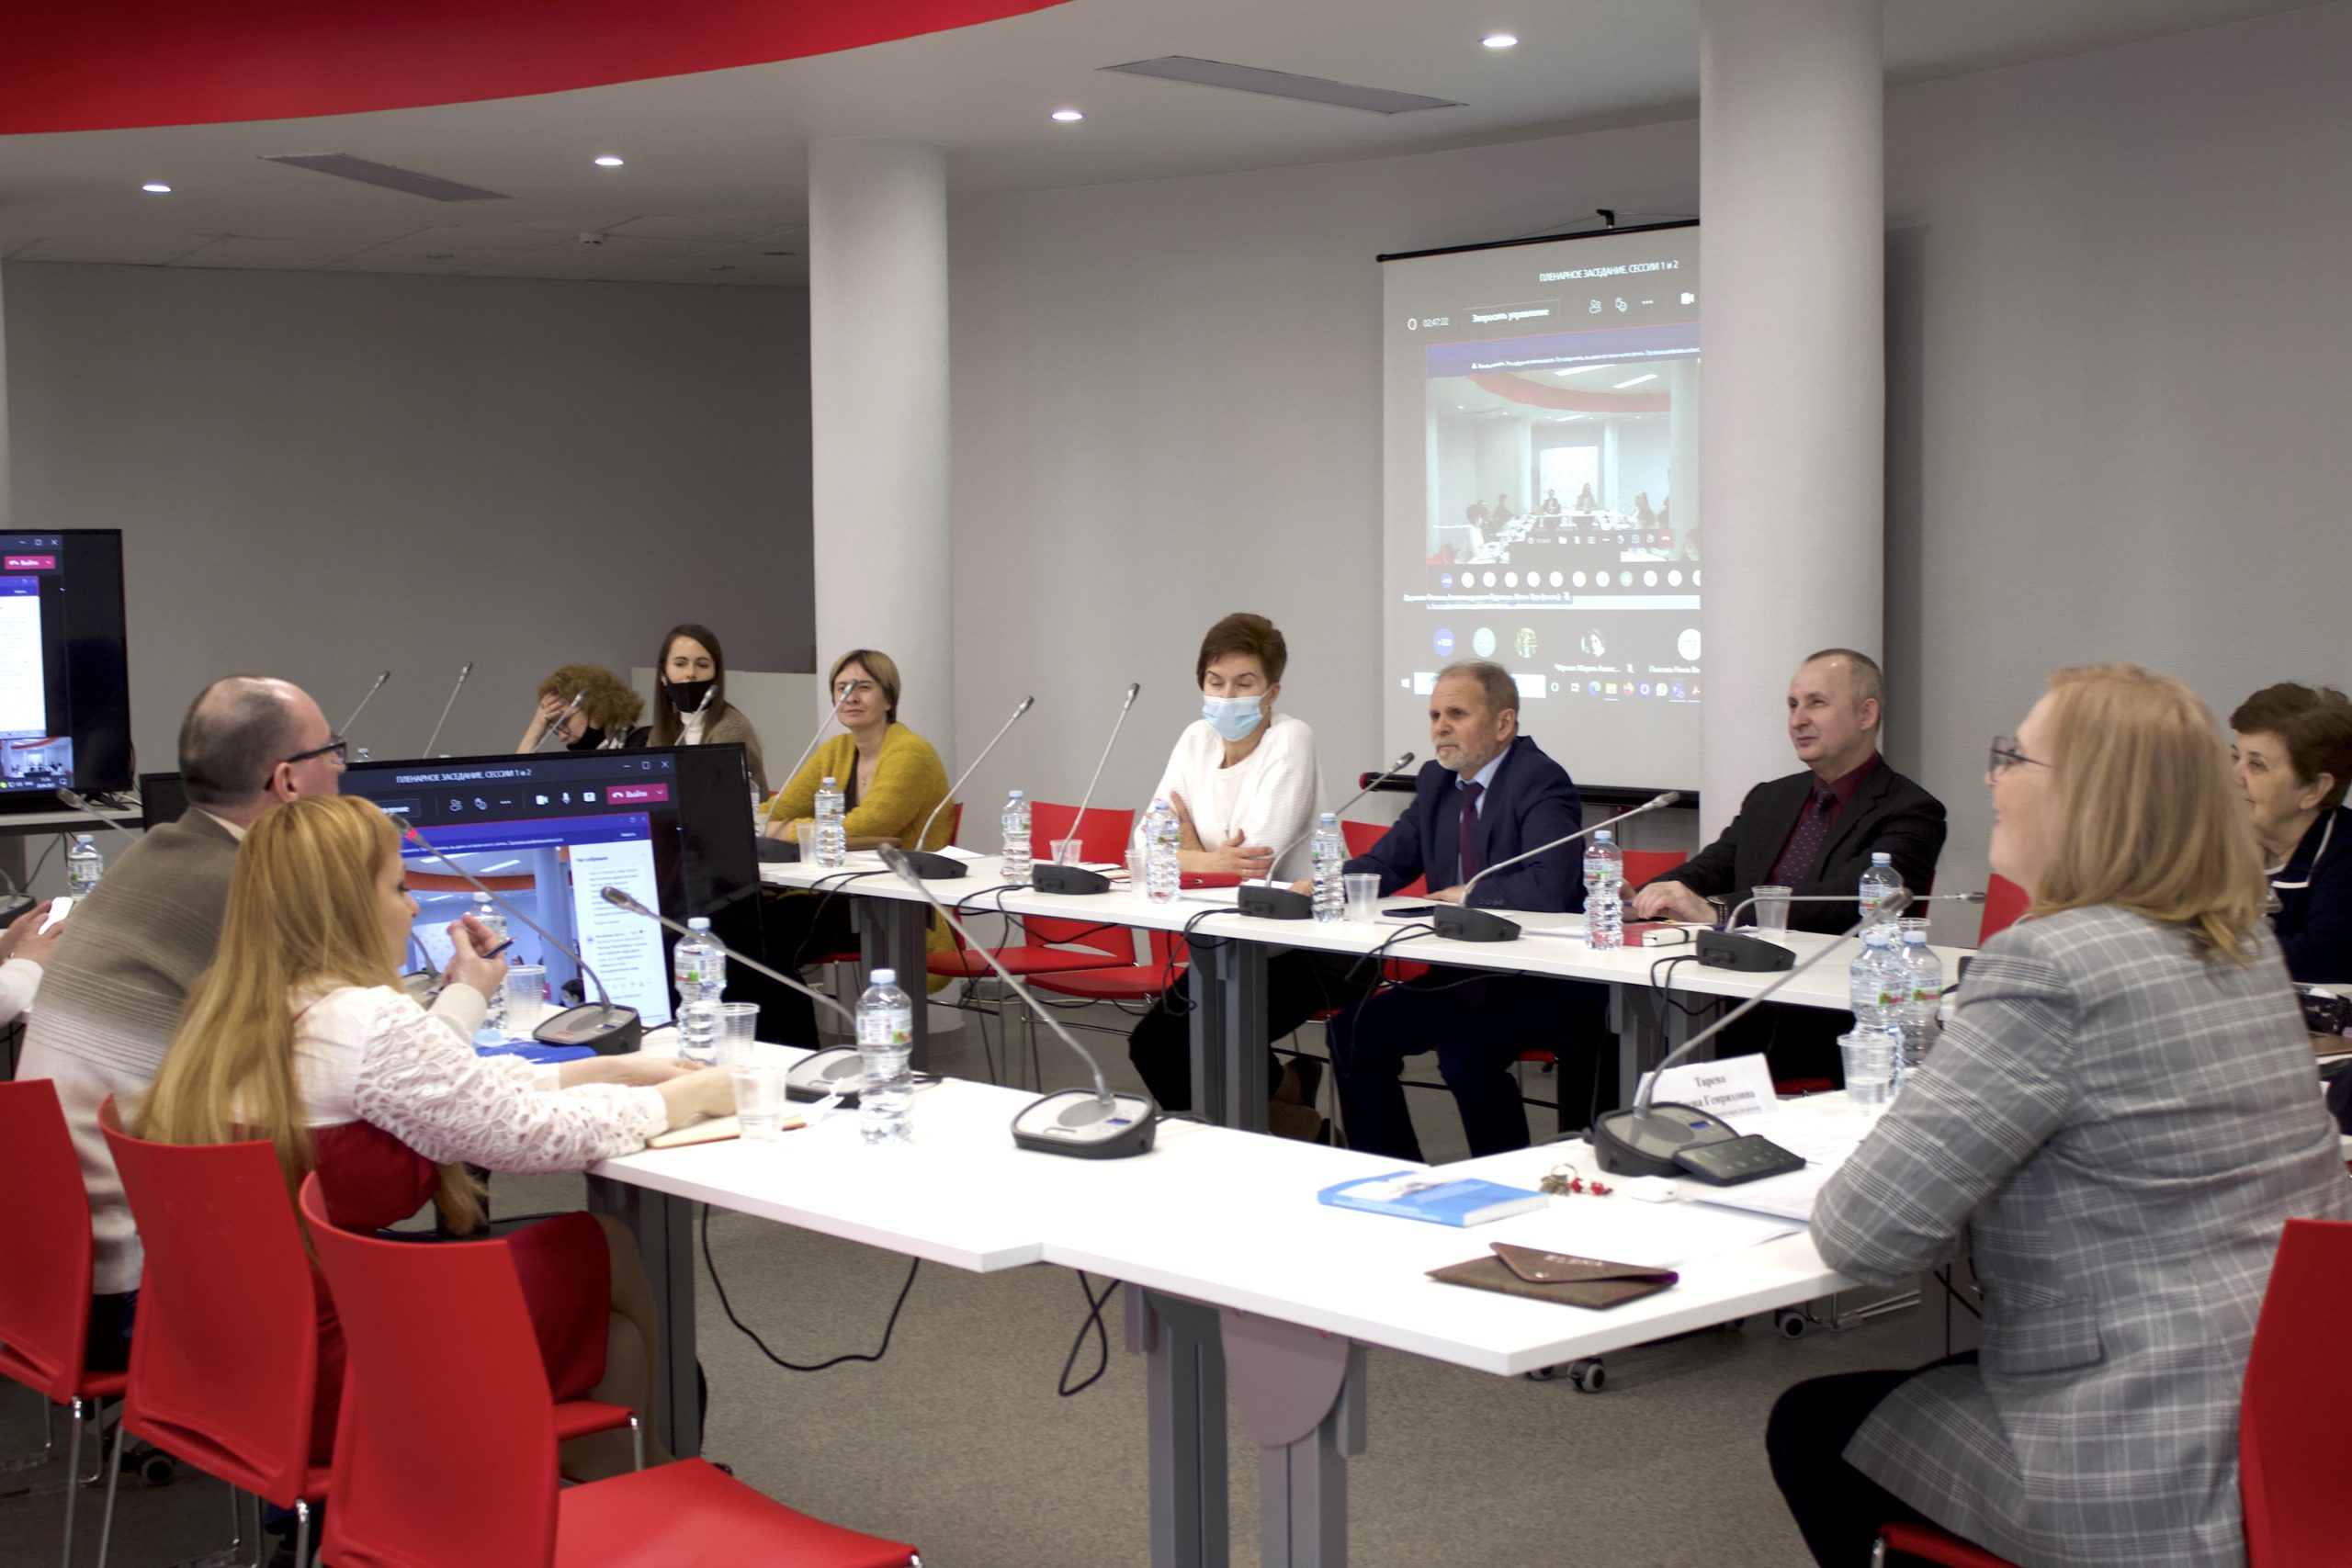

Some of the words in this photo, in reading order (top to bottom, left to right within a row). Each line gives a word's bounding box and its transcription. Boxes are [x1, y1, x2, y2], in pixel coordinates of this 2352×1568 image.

[1539, 269, 1583, 282] ПЛЕНАРНОЕ
[1628, 262, 1660, 274] СЕССИИ
[1673, 260, 1679, 269] 2
[396, 773, 440, 784] ПЛЕНАРНОЕ
[485, 770, 515, 779] СЕССИИ
